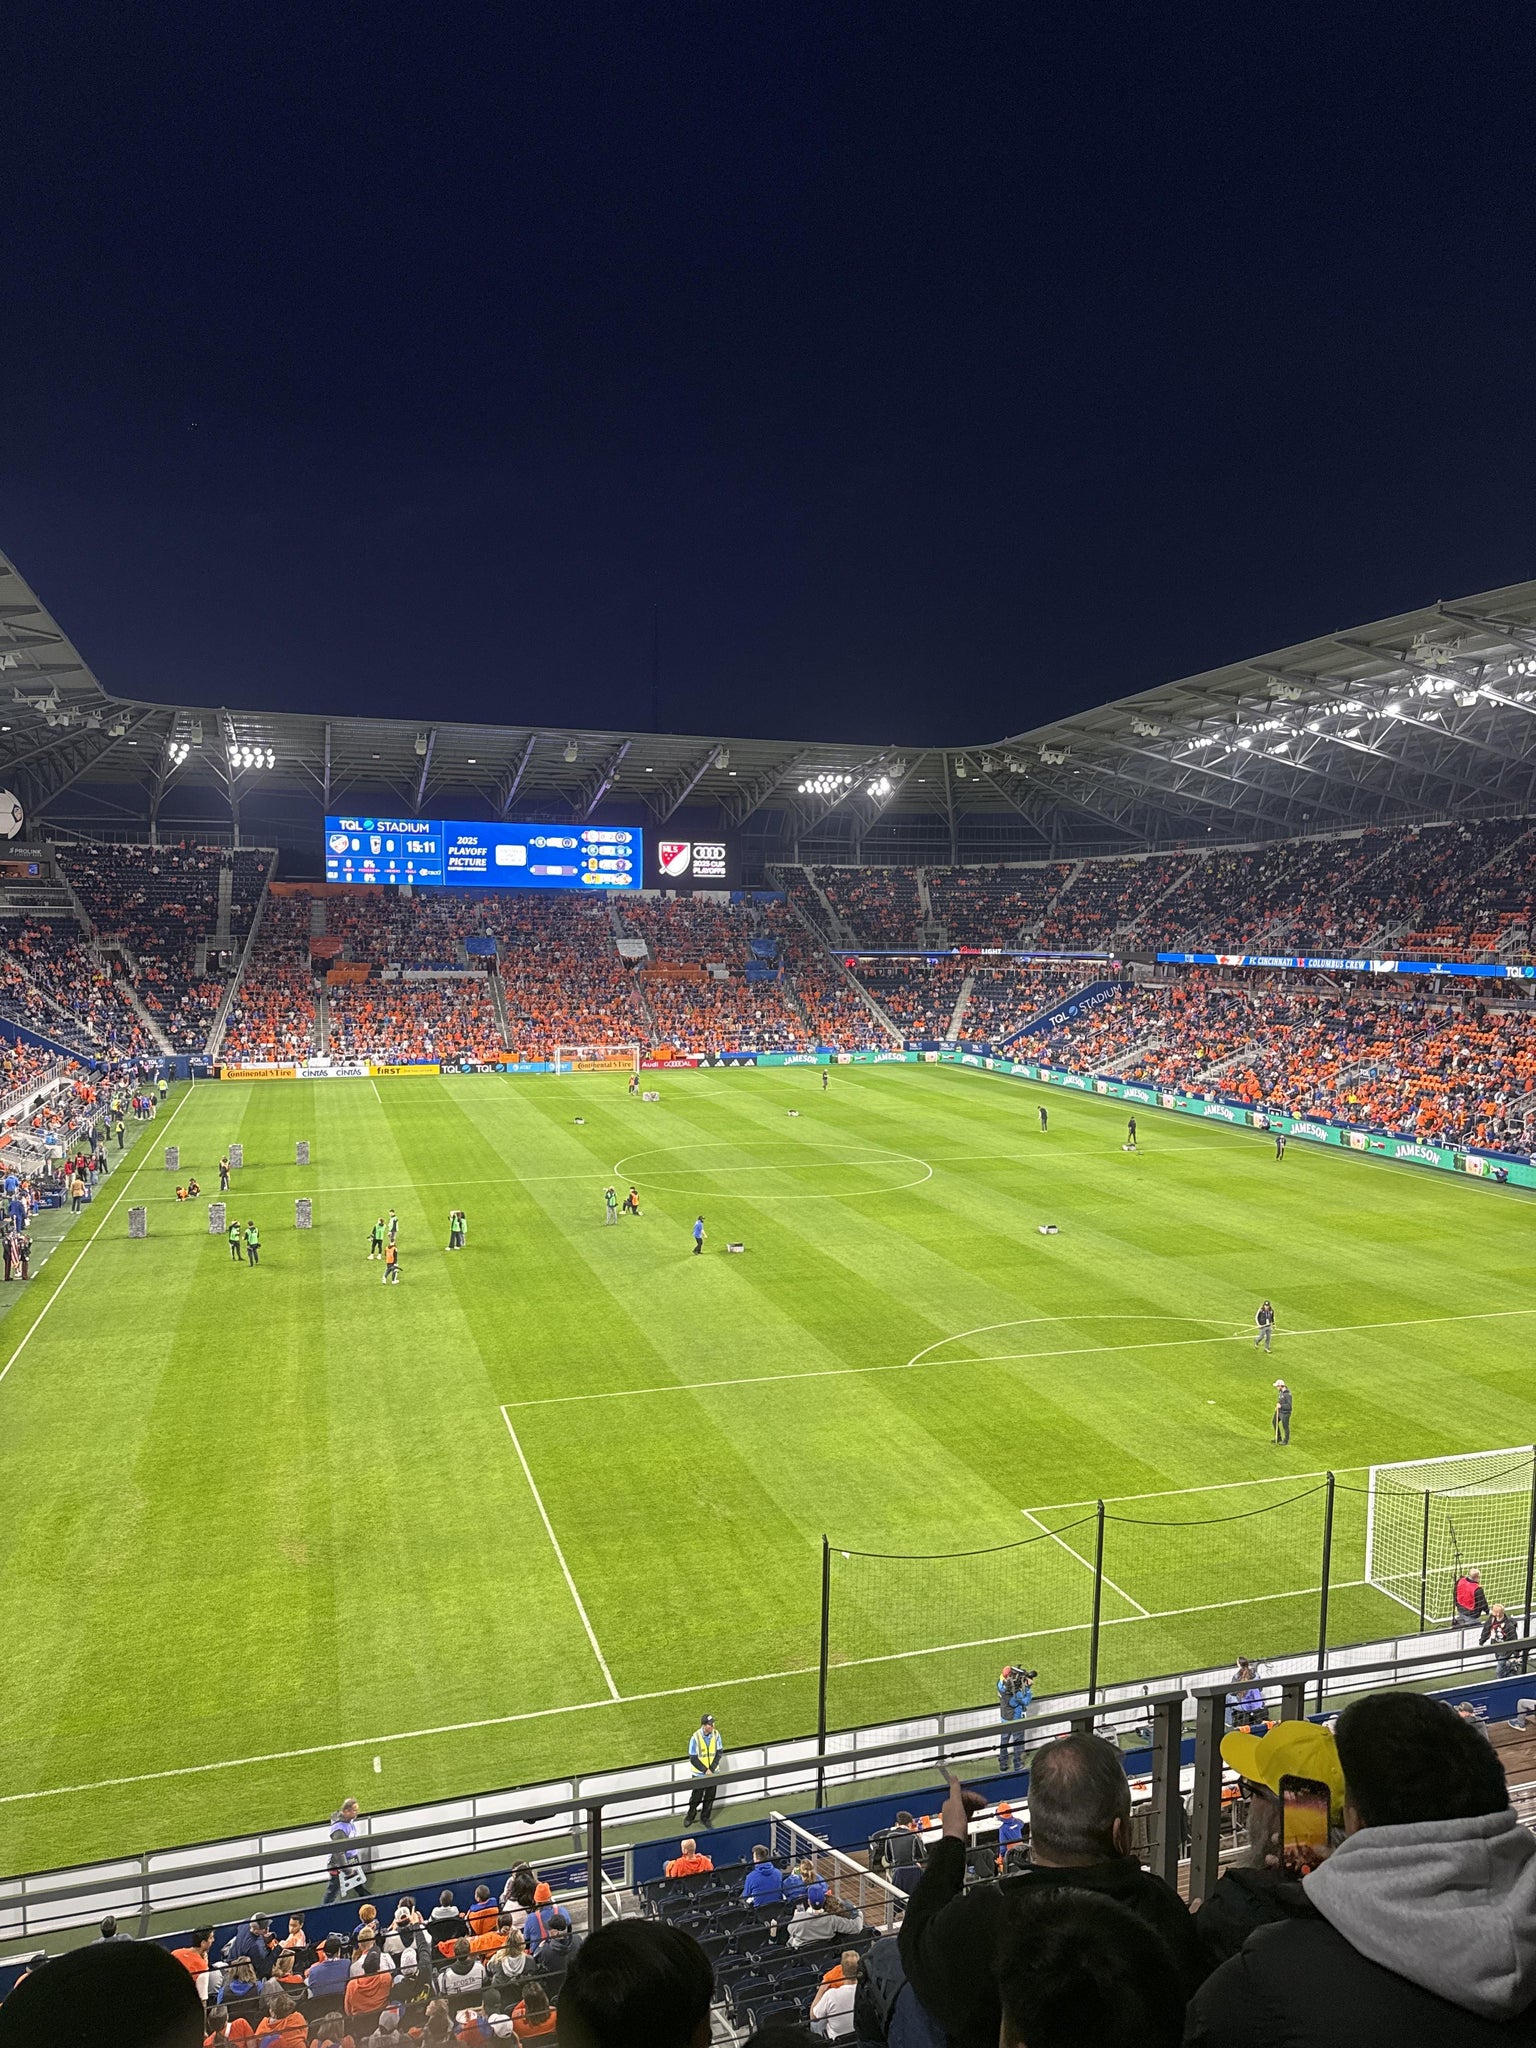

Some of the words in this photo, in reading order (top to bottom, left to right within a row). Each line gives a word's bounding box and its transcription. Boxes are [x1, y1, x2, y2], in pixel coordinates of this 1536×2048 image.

[339, 820, 363, 831] TQL
[377, 822, 430, 833] STADIUM
[352, 838, 360, 851] 0
[386, 839, 394, 852] 0
[456, 836, 478, 845] 2025
[406, 840, 436, 853] 15:11
[448, 847, 488, 856] PLAYOFF
[448, 857, 488, 866] PICTURE
[1249, 957, 1257, 965] FC
[1257, 957, 1293, 967] CINCINNATI
[1308, 960, 1344, 968] COLUMBUS
[1345, 961, 1366, 969] CREW
[1505, 966, 1525, 978] TQL
[1048, 1011, 1070, 1026] TQL
[1078, 983, 1123, 1012] STADIUM
[783, 1055, 818, 1065] JAMESON
[873, 1053, 907, 1063] JAMESON
[441, 1066, 461, 1074] TQL
[476, 1065, 495, 1073] TQL
[577, 1061, 612, 1070] Continental
[227, 1070, 268, 1078] Continental
[1123, 1088, 1150, 1102] JAMESON
[1203, 1104, 1235, 1121] JAMESON
[1289, 1122, 1328, 1141] JAMESON
[1395, 1144, 1441, 1165] JAMESON
